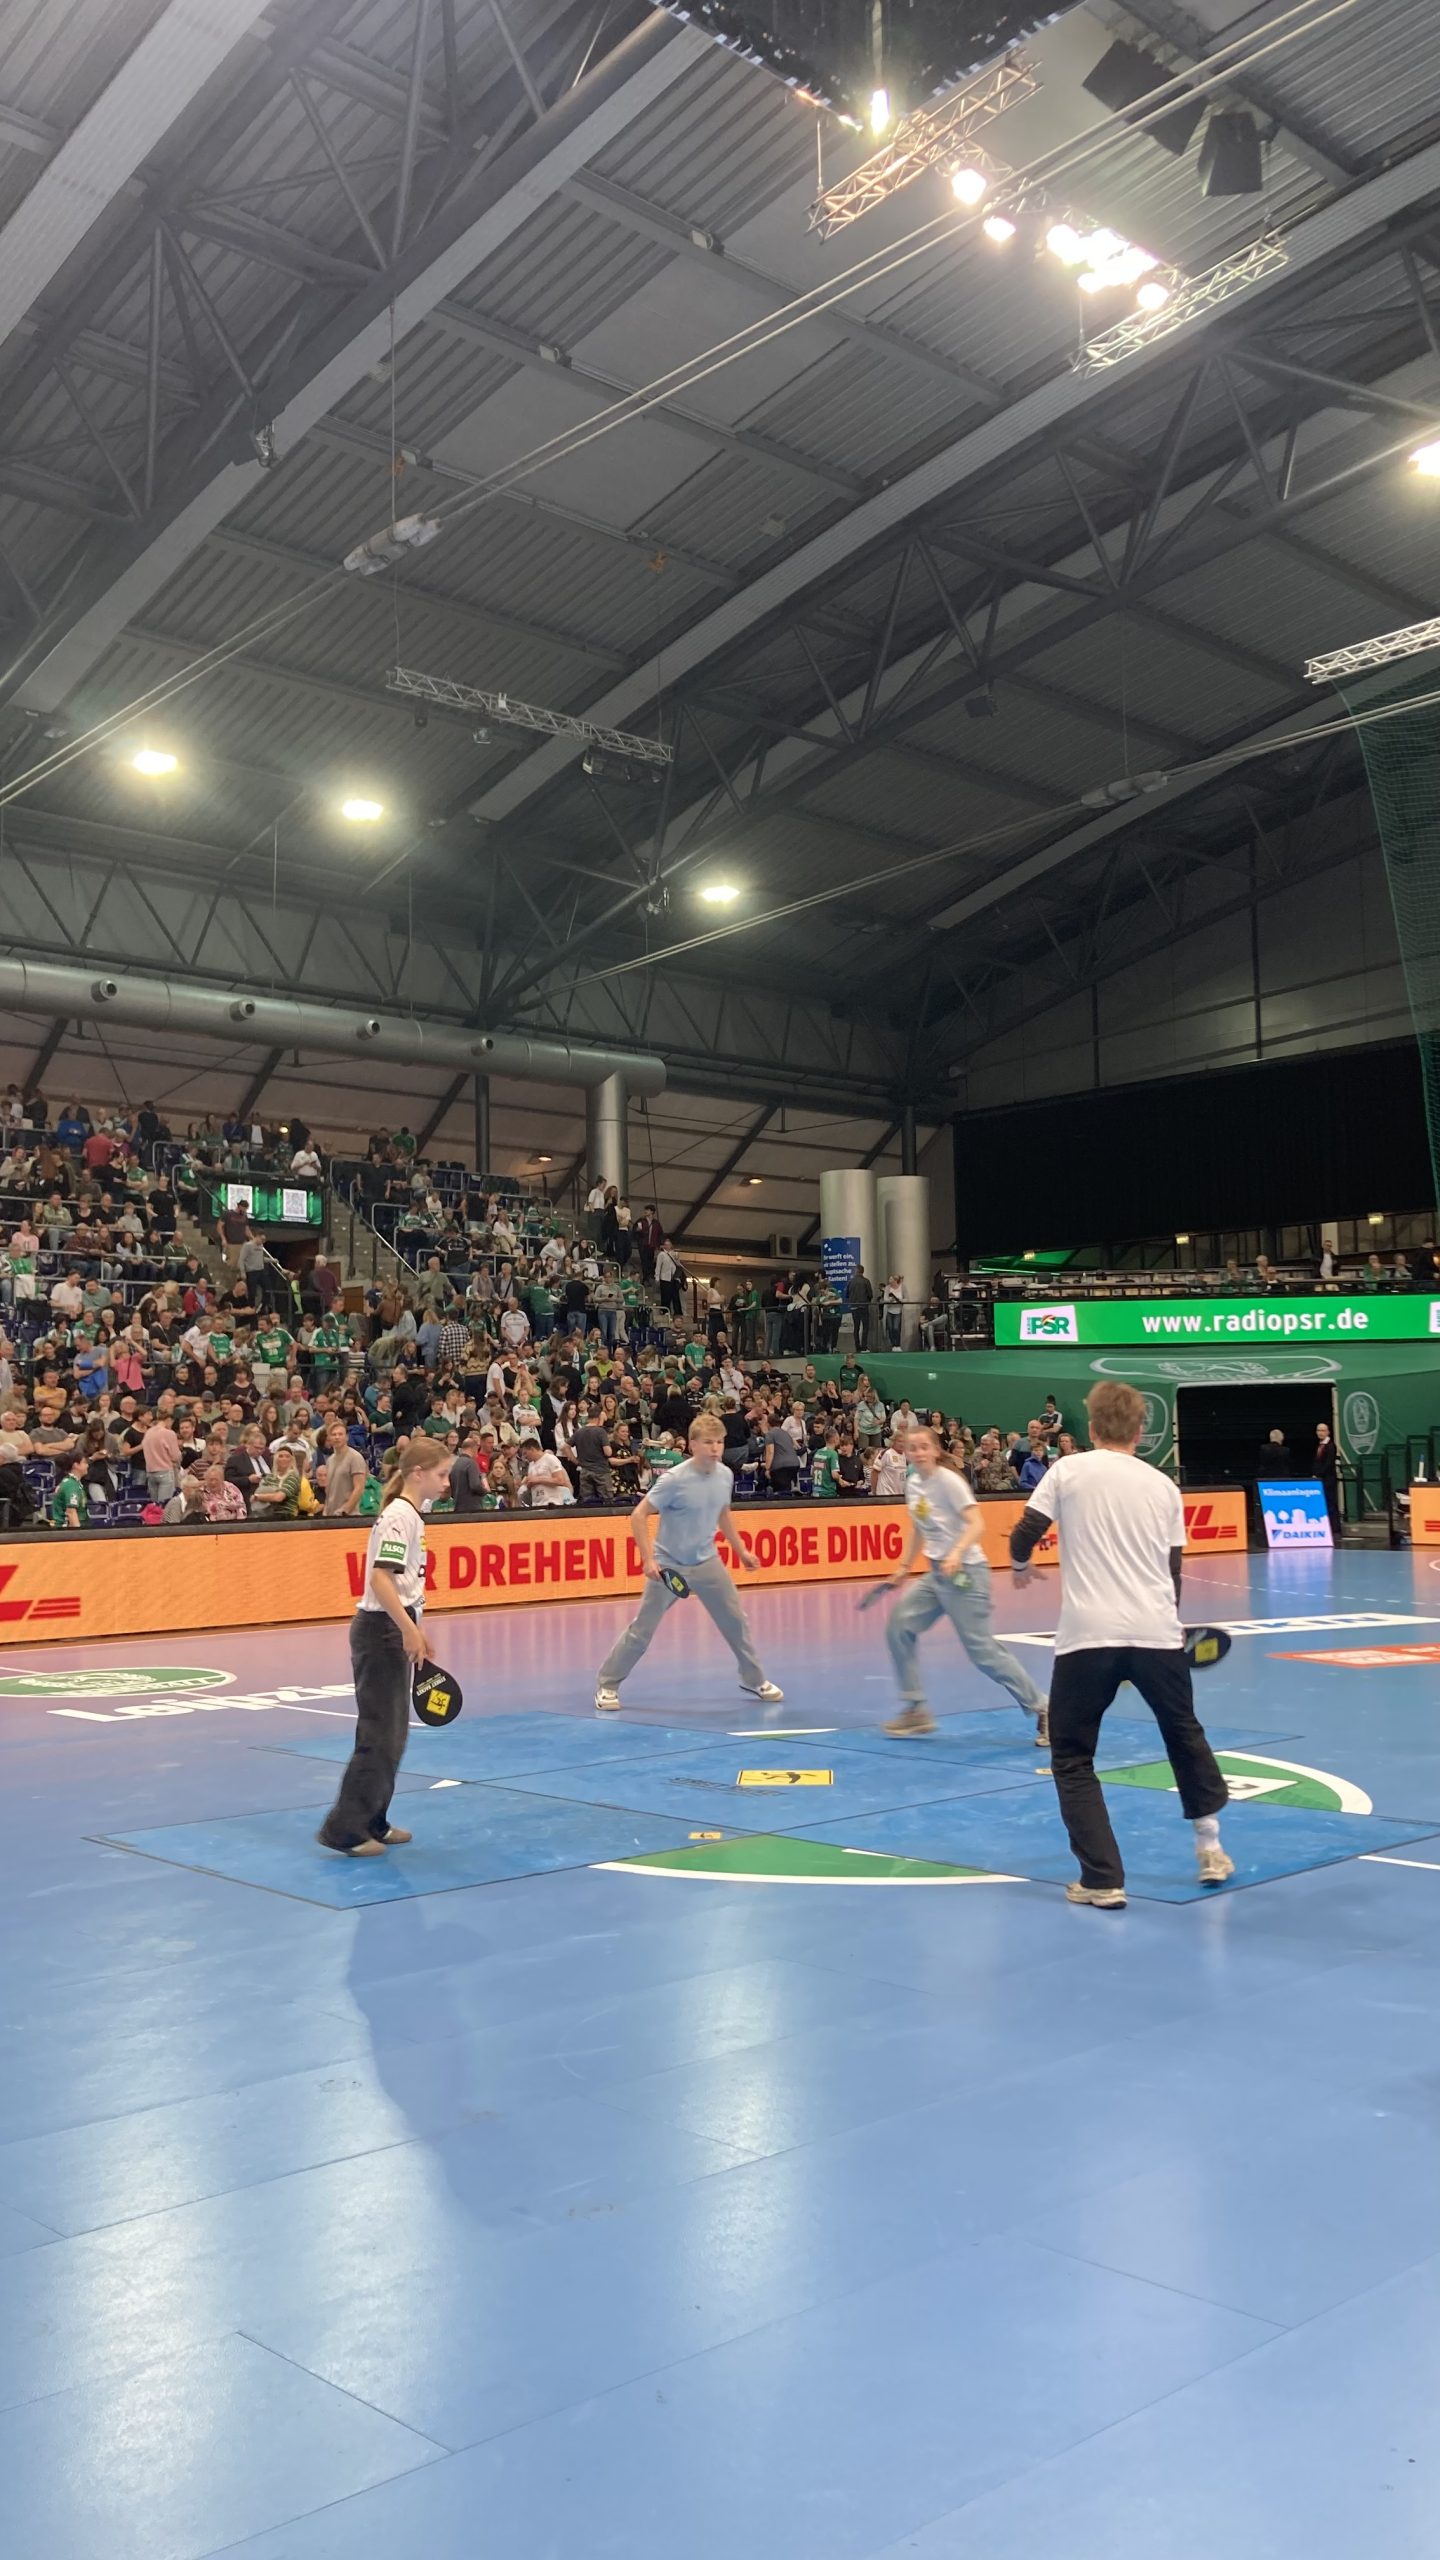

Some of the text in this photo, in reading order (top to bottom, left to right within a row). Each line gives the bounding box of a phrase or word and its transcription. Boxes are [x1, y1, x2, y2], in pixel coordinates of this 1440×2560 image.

[1031, 1315, 1070, 1335] PSR
[1141, 1308, 1370, 1335] www.radiopsr.de
[1282, 1531, 1326, 1539] DAIKIN
[449, 1537, 615, 1590] DREHEN
[827, 1523, 903, 1563] DING
